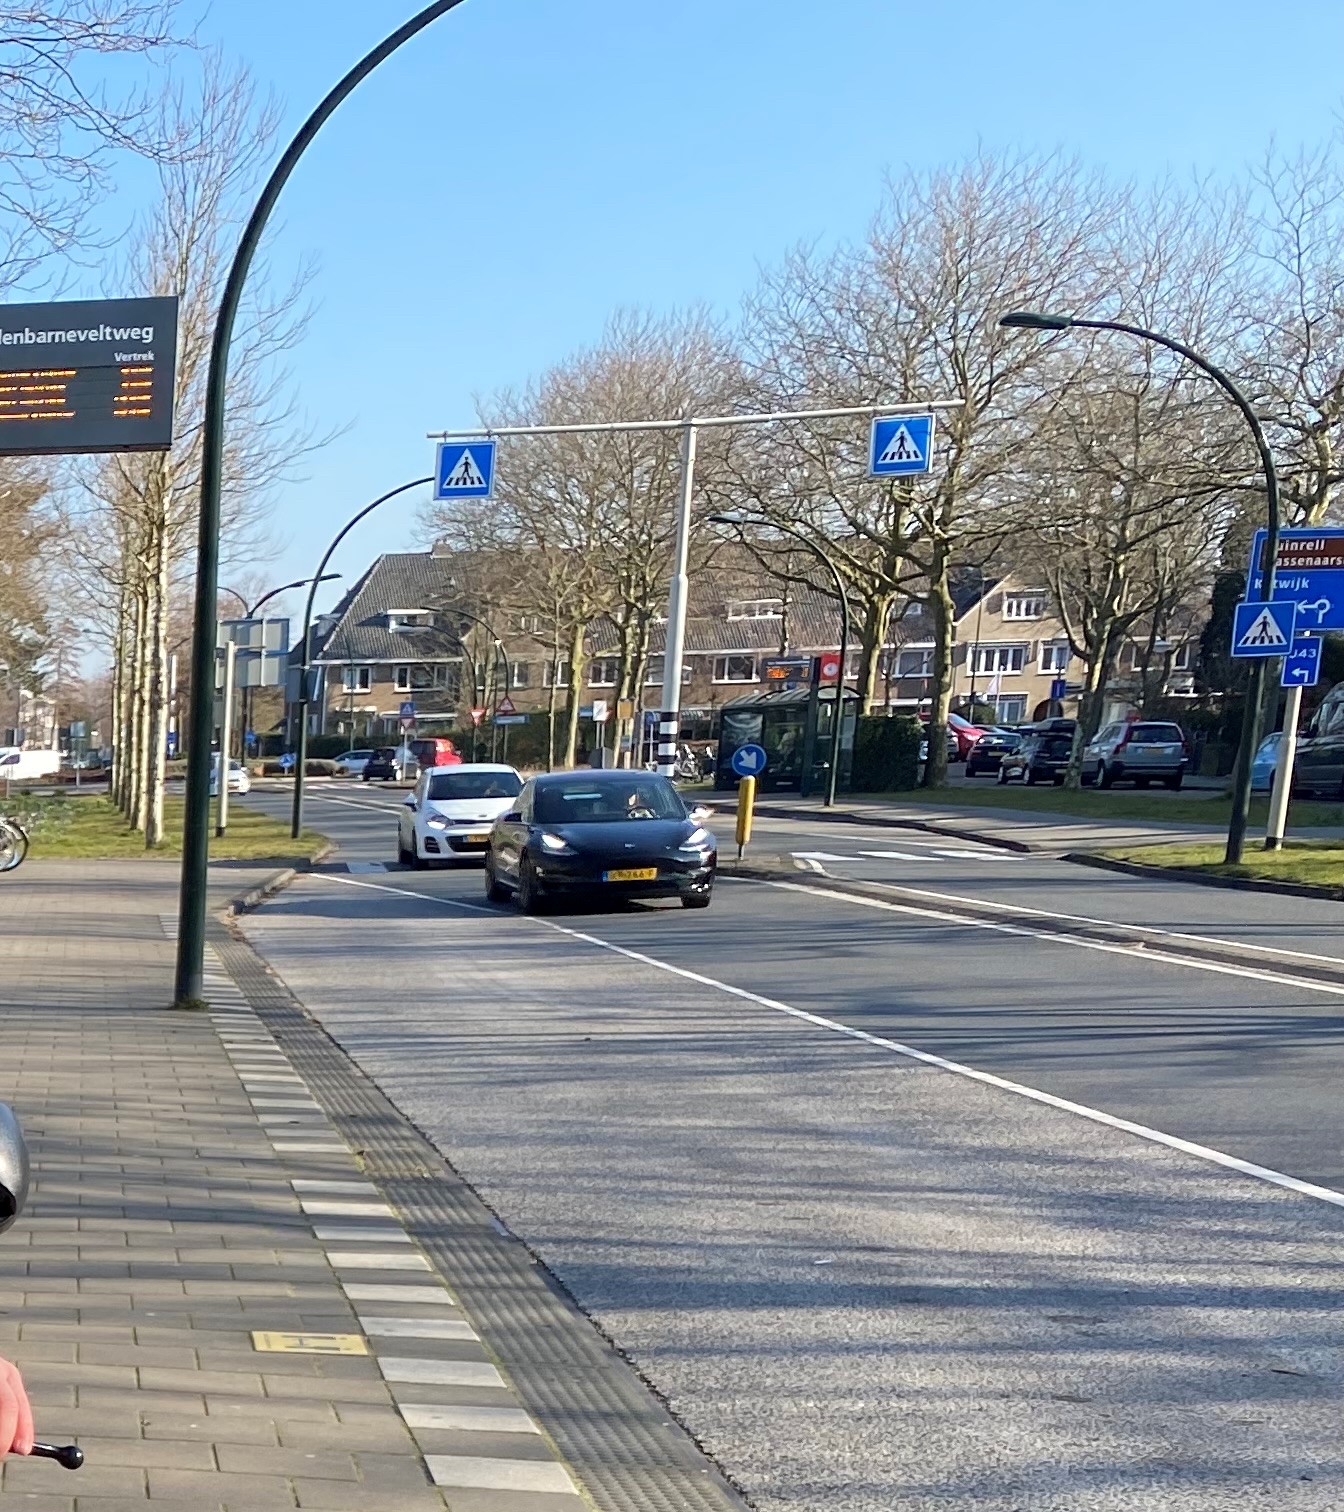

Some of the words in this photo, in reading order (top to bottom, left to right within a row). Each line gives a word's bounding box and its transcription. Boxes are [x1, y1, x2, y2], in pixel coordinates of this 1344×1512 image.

[114, 350, 155, 362] Vertrek
[1278, 539, 1325, 551] uinrell
[1275, 556, 1344, 567] assenaars
[1254, 578, 1310, 592] Ktwijk
